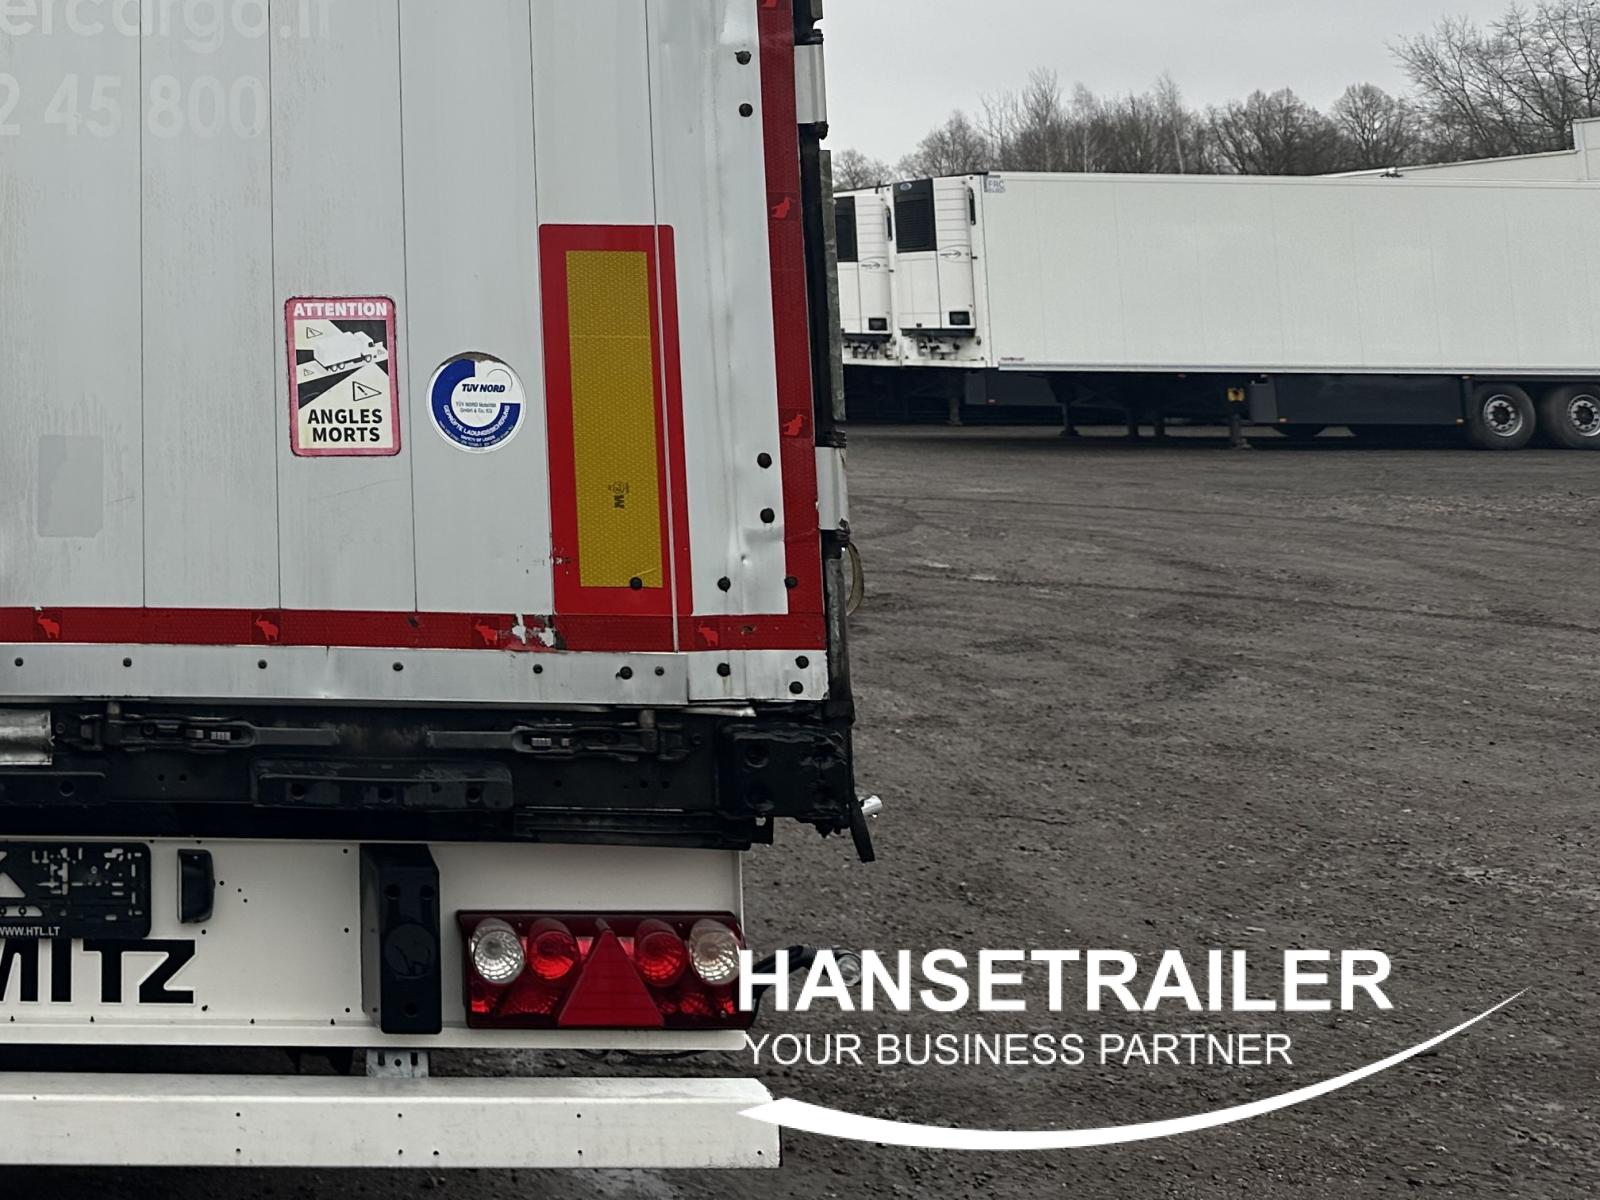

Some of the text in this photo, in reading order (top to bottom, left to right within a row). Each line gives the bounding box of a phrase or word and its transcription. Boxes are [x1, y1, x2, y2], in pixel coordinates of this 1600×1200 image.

[44, 74, 122, 138] 45
[148, 75, 268, 139] 800
[293, 302, 388, 317] ATTENTION
[480, 384, 506, 393] NORD
[307, 409, 382, 424] ANGLES
[312, 427, 380, 442] MORTS
